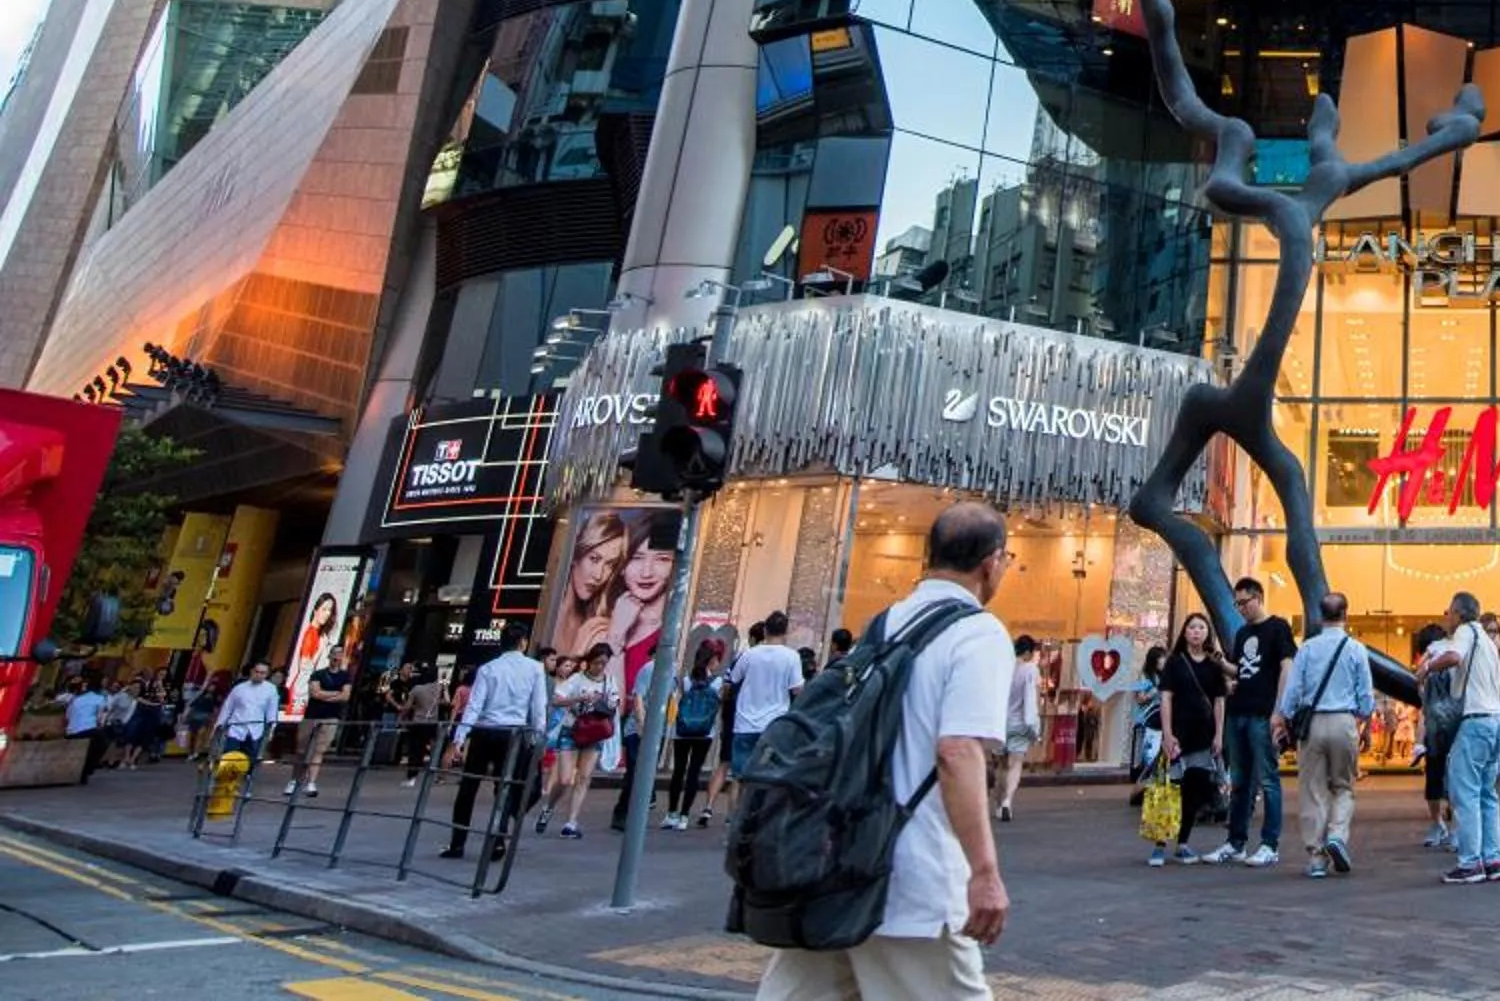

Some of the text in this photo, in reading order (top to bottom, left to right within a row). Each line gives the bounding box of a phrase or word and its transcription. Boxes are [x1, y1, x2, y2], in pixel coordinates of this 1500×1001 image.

[571, 393, 661, 428] AROVS
[986, 396, 1152, 447] SWAROVSKI
[411, 459, 480, 487] TISSOT
